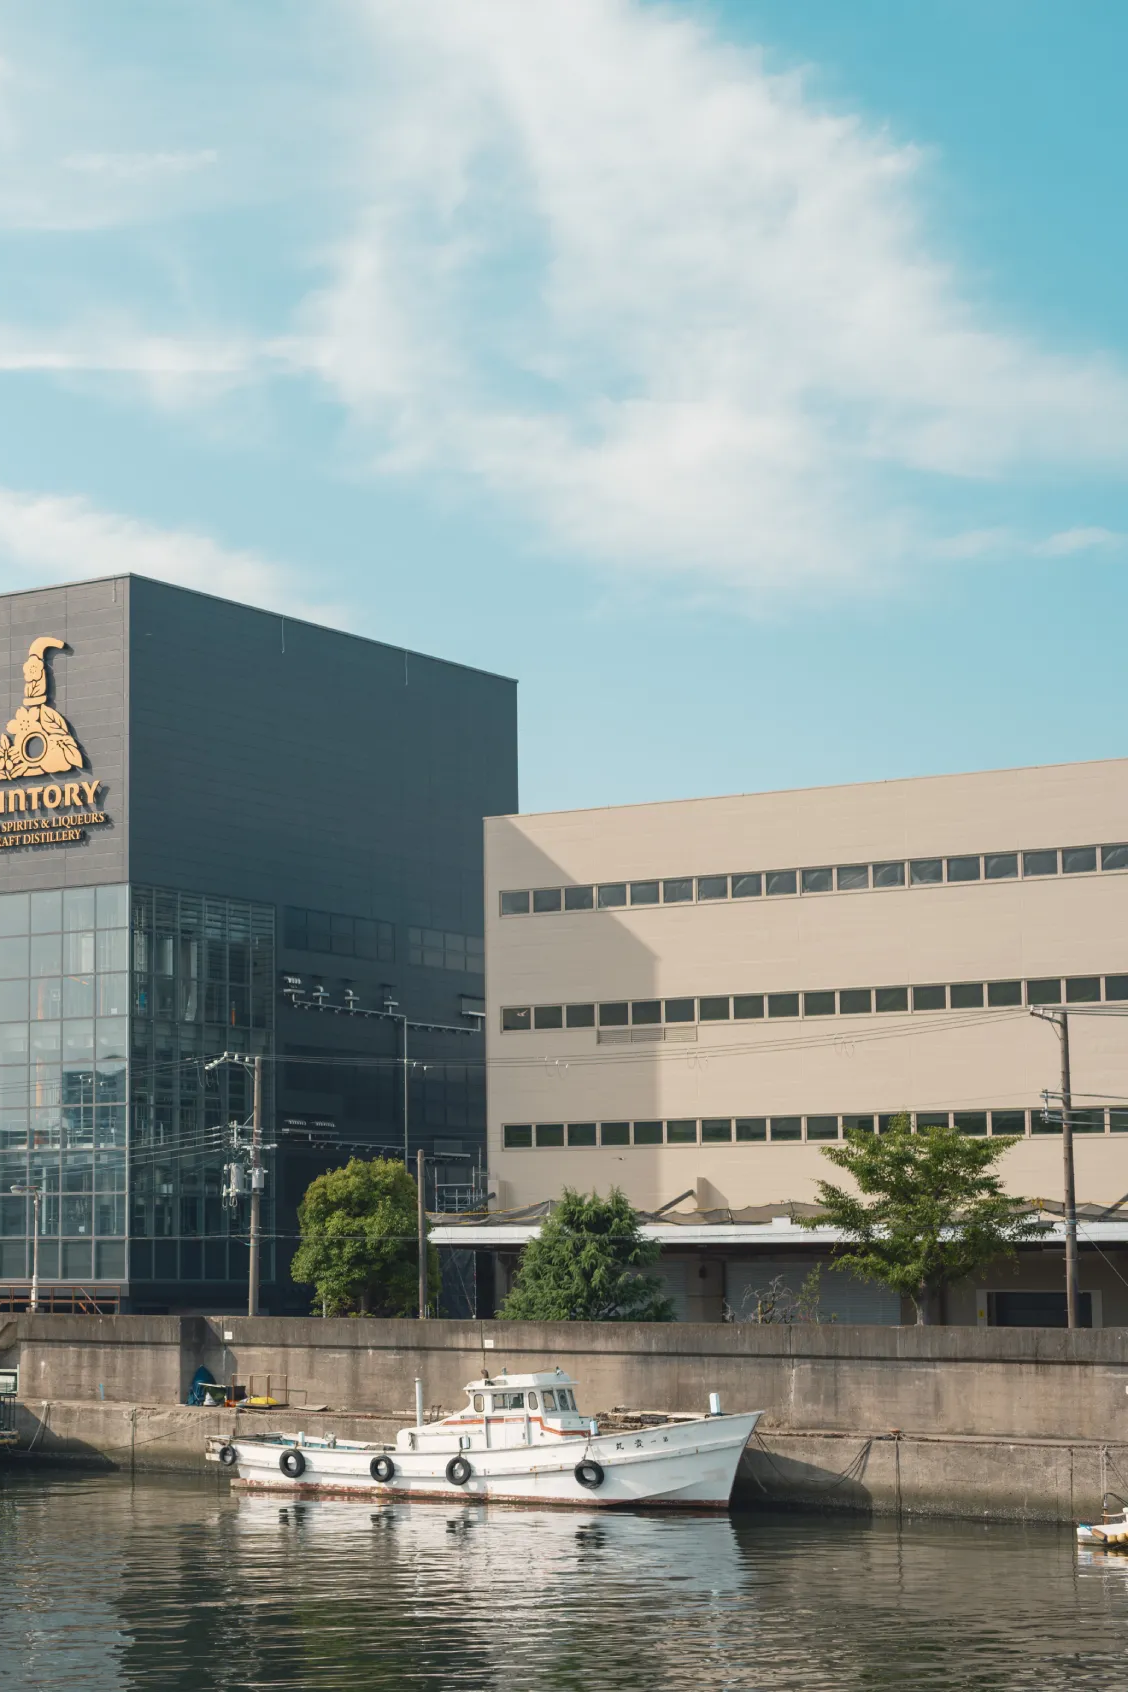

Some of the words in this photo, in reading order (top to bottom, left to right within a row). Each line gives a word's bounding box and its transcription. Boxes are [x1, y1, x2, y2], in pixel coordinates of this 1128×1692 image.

[2, 819, 39, 832] SPIRITS
[41, 819, 50, 828] &
[52, 812, 104, 829] LIQUEURS
[23, 829, 81, 844] DISTILLERY
